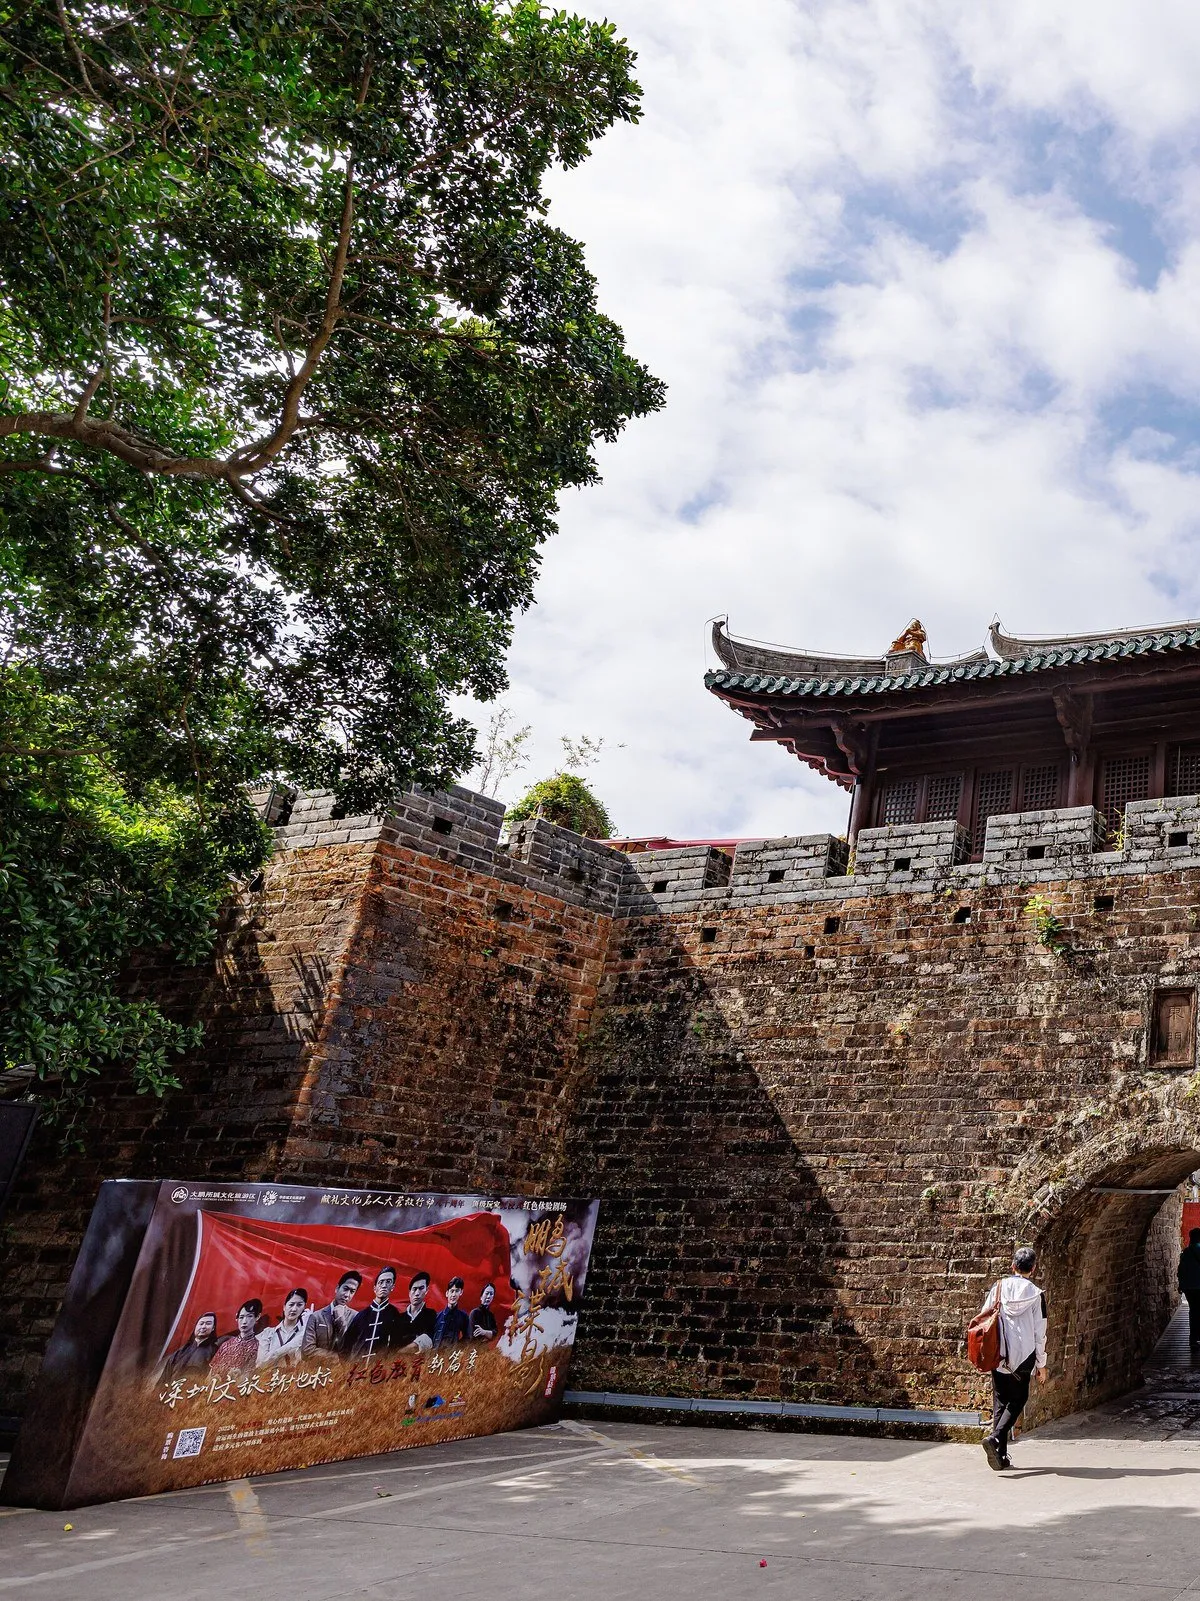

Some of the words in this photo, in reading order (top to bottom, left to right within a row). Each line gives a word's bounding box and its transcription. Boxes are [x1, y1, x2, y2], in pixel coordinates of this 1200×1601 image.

[159, 1366, 333, 1409] 深圳文旅新地标
